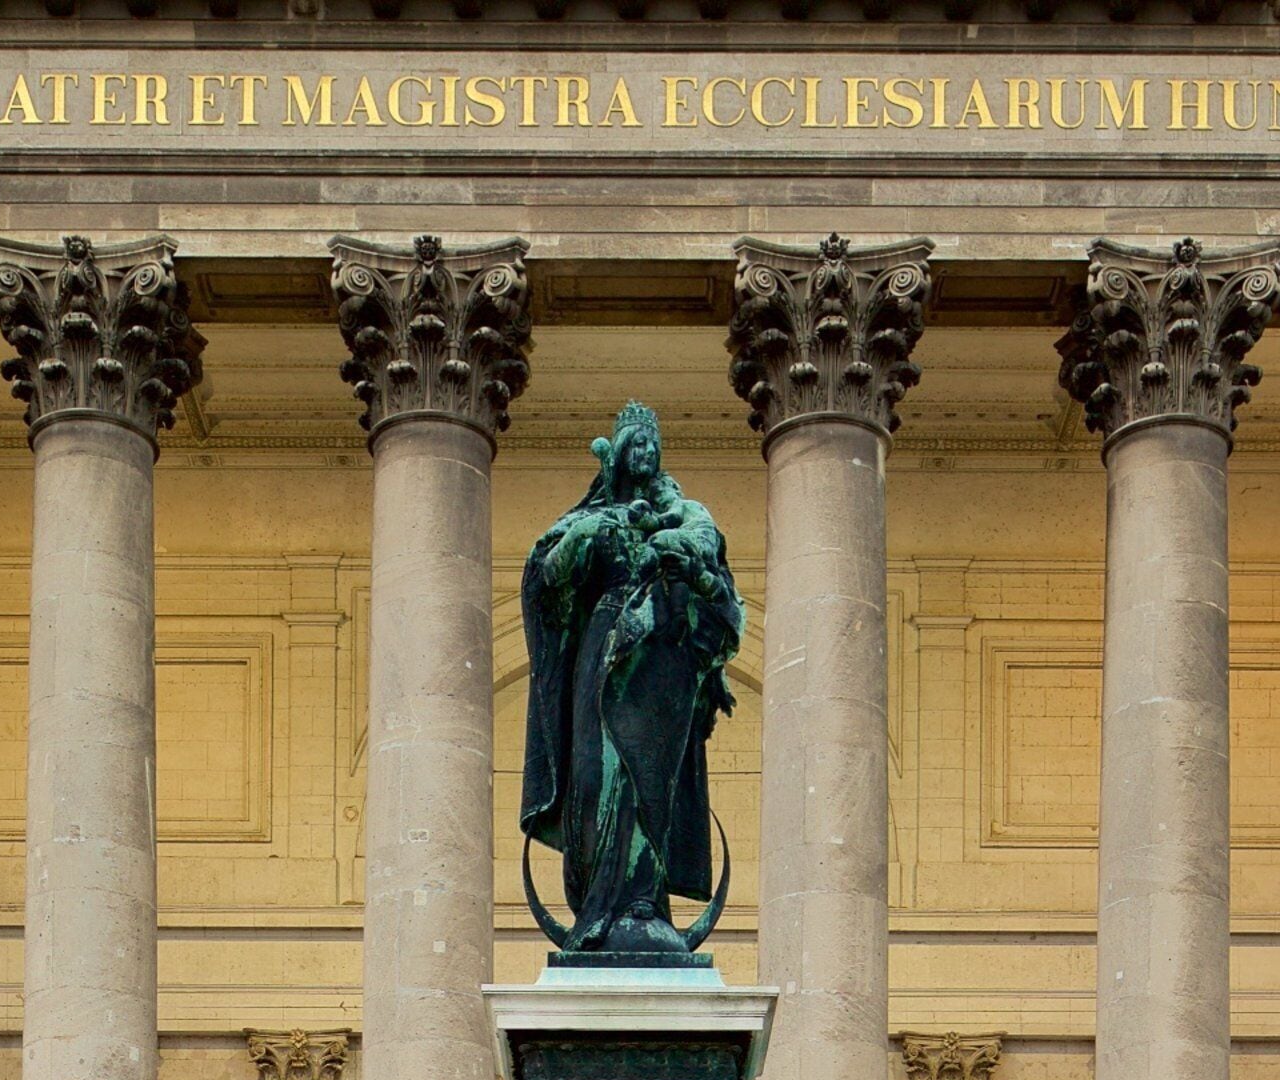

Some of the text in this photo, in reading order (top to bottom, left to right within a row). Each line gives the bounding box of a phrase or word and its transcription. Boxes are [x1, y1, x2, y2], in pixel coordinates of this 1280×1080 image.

[188, 72, 268, 125] ET
[282, 72, 640, 127] MAGISTRA
[659, 75, 1150, 129] ECCLESIARUM
